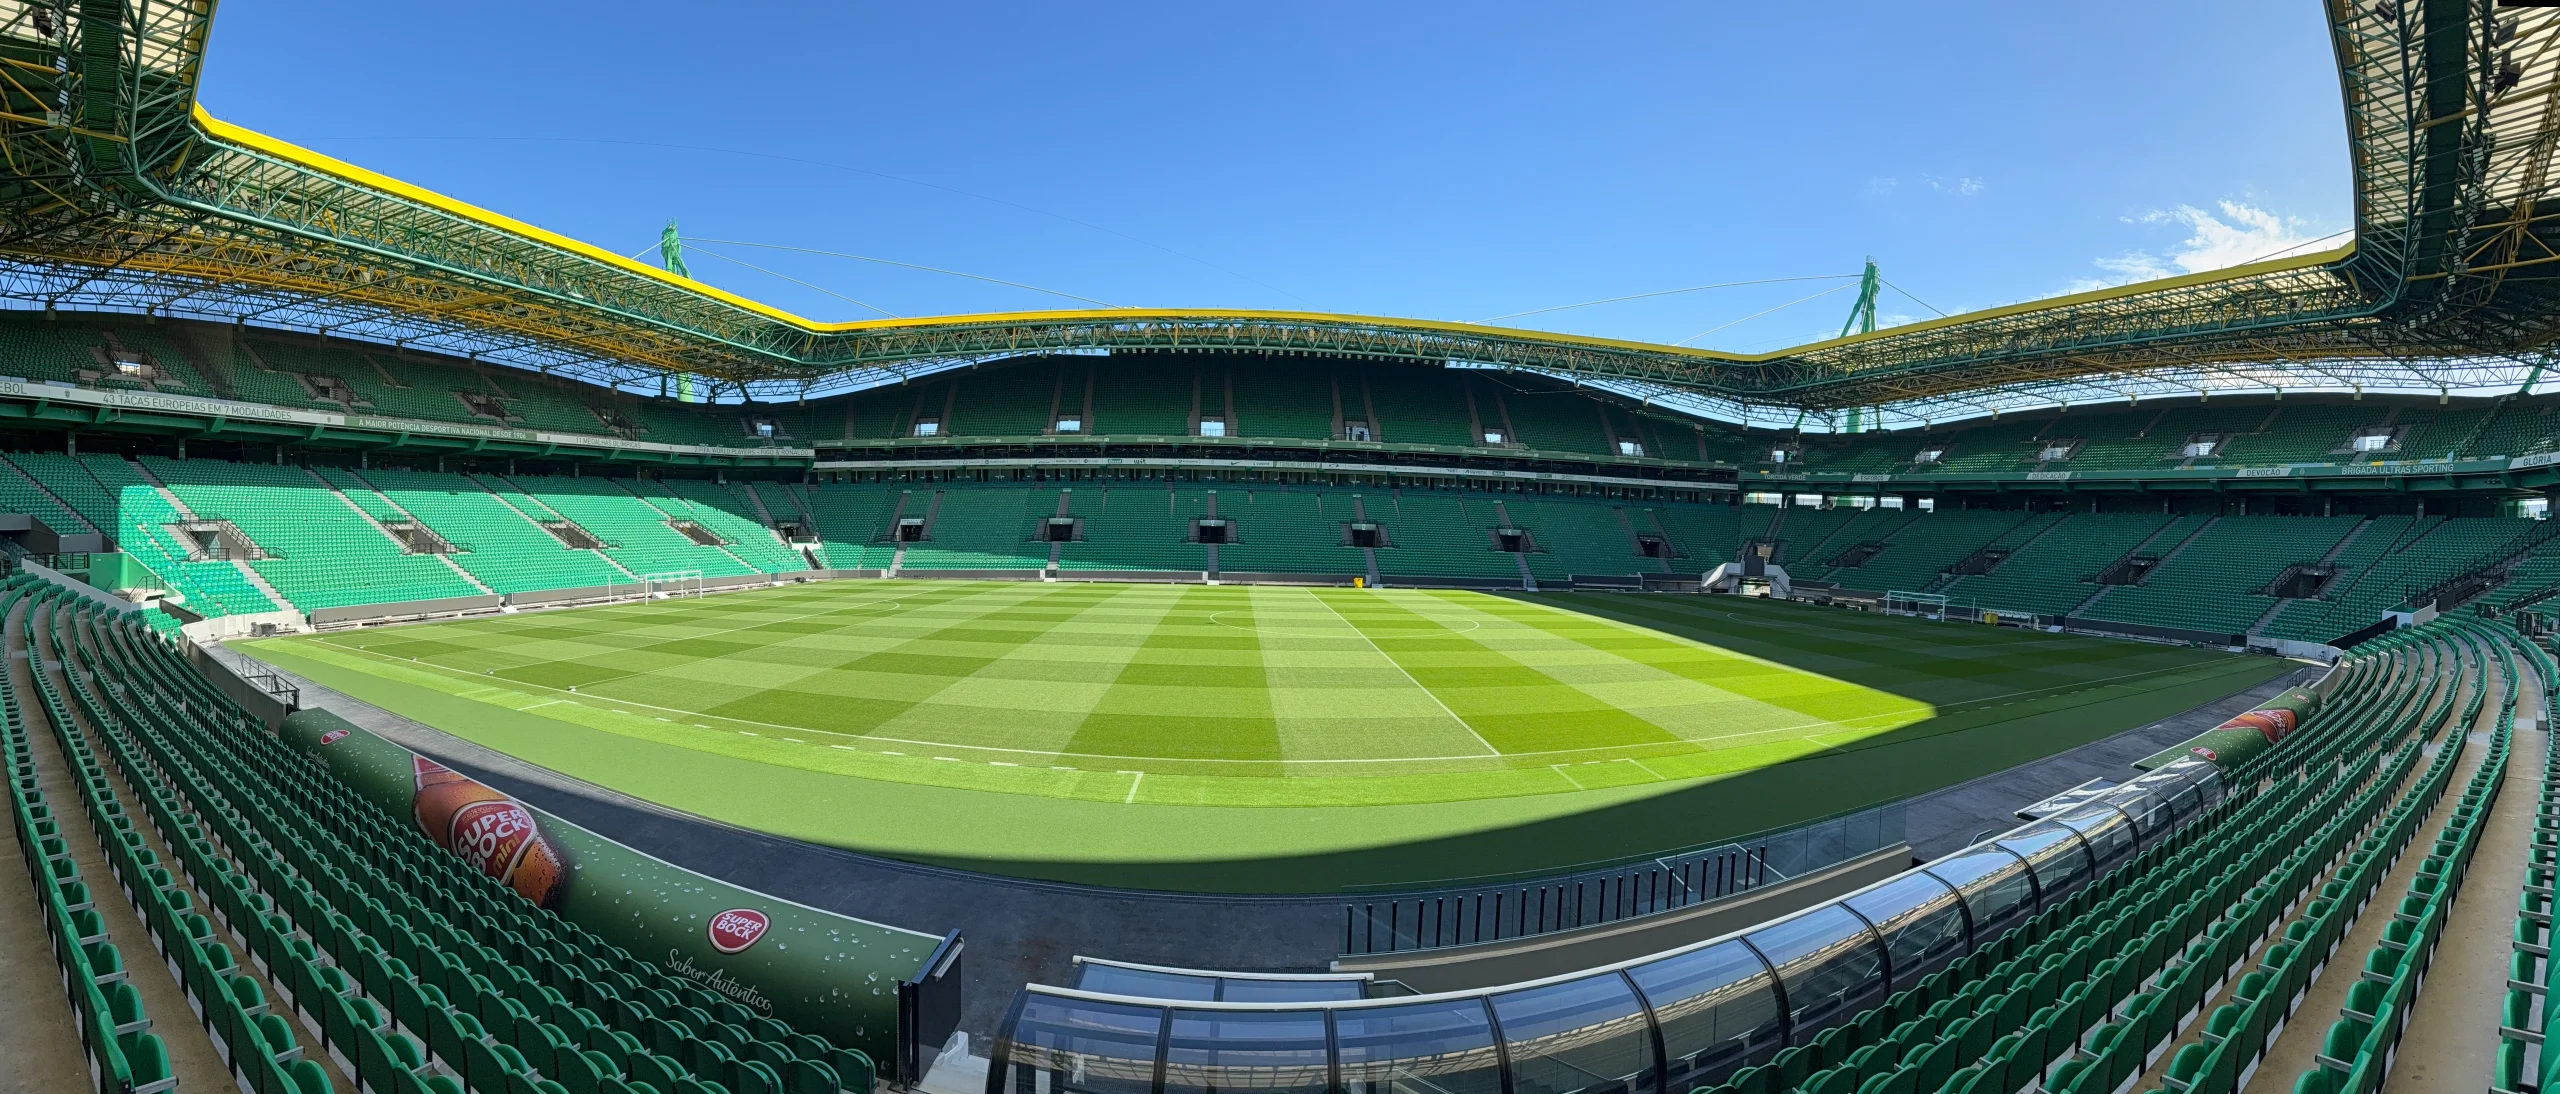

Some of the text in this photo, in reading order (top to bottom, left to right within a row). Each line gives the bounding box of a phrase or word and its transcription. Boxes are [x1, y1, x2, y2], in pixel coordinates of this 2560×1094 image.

[103, 394, 115, 404] 43
[152, 398, 206, 412] EUROPEIAS
[208, 405, 222, 414] EM
[224, 405, 230, 414] 7
[231, 407, 292, 420] MODALIDADES
[365, 419, 387, 429] MAIOR
[388, 420, 420, 431] POTÊNCIA
[421, 424, 461, 435] DESPORTIVA
[461, 428, 492, 437] NACIONAL
[492, 431, 512, 439] DESDE
[513, 432, 527, 440] 1906
[583, 438, 612, 446] MEDALHAS
[2341, 463, 2454, 476] BRIGADA ULTRAS SPORTING
[2523, 454, 2552, 467] GLÓRIA
[457, 809, 525, 864] SUPER
[470, 817, 529, 877] BOCK
[492, 833, 521, 874] mini
[716, 919, 755, 940] BOCK
[721, 911, 763, 932] SUPER
[665, 948, 773, 1014] Sabor Autêntico
